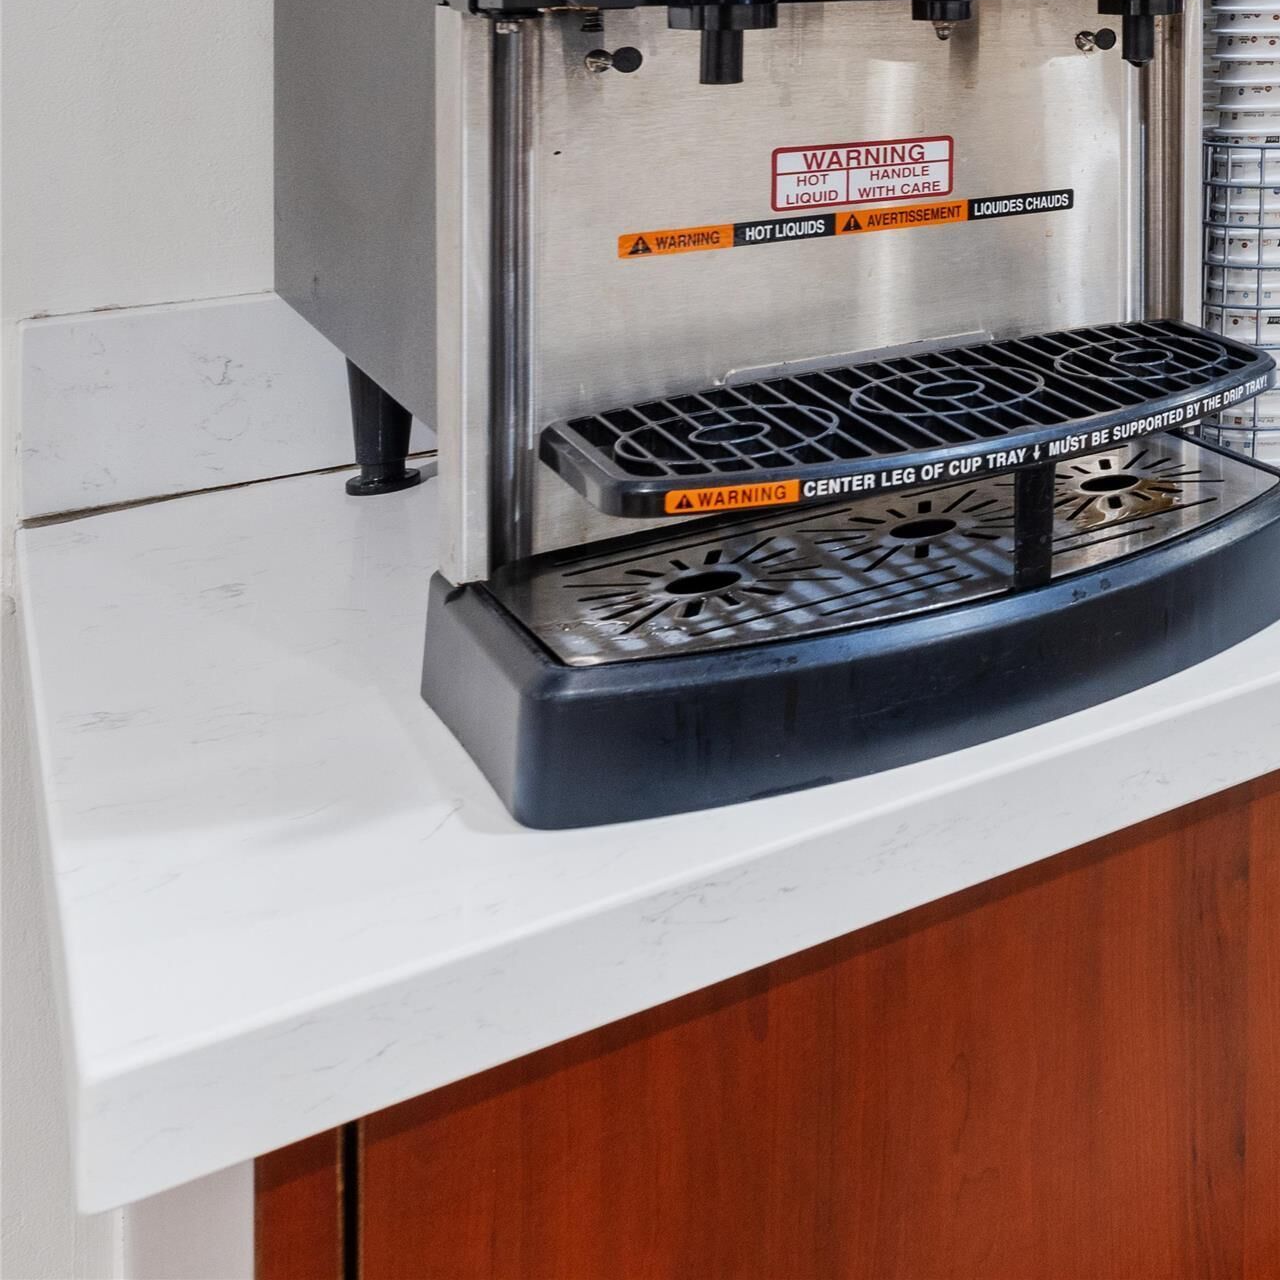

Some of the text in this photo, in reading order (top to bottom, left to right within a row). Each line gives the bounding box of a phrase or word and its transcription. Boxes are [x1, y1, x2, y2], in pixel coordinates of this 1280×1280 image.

[803, 144, 925, 170] WARNING
[796, 173, 829, 187] HOT
[870, 165, 930, 181] HANDLE
[786, 189, 839, 205] LIQUID
[858, 180, 941, 199] WITH CARE
[655, 193, 1070, 250] WARNING HOT LIQUIDS AVERTISSEMENT LIQUIDES CHAUDS
[697, 375, 1268, 507] WARNING CENTER LEG OF CUP TRAY MUST BE SUPPORTED BY THE DRIP TRAY!
